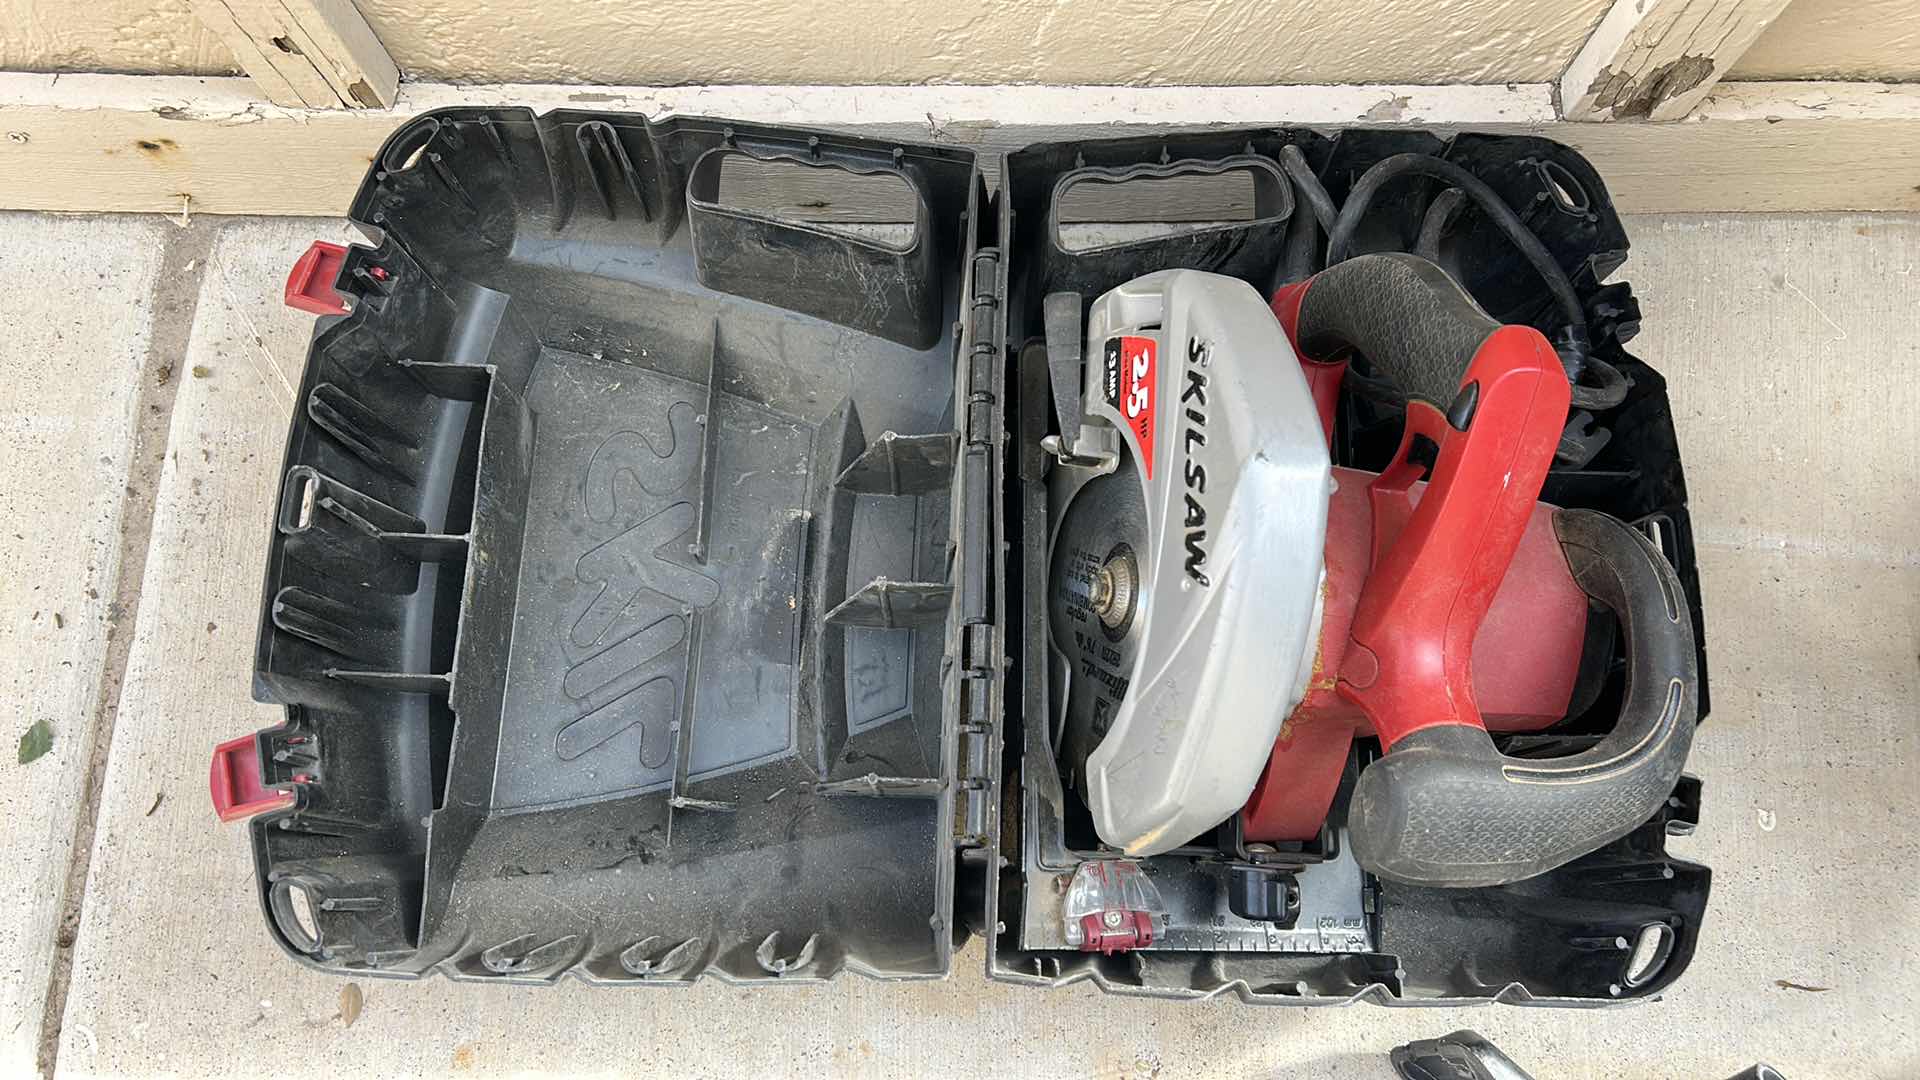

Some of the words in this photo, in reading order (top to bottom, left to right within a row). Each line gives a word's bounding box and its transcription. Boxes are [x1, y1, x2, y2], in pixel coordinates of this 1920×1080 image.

[1108, 351, 1117, 369] 13
[1108, 370, 1117, 399] AMP
[1126, 348, 1150, 419] 2.5
[1182, 337, 1215, 587] SKILSAW
